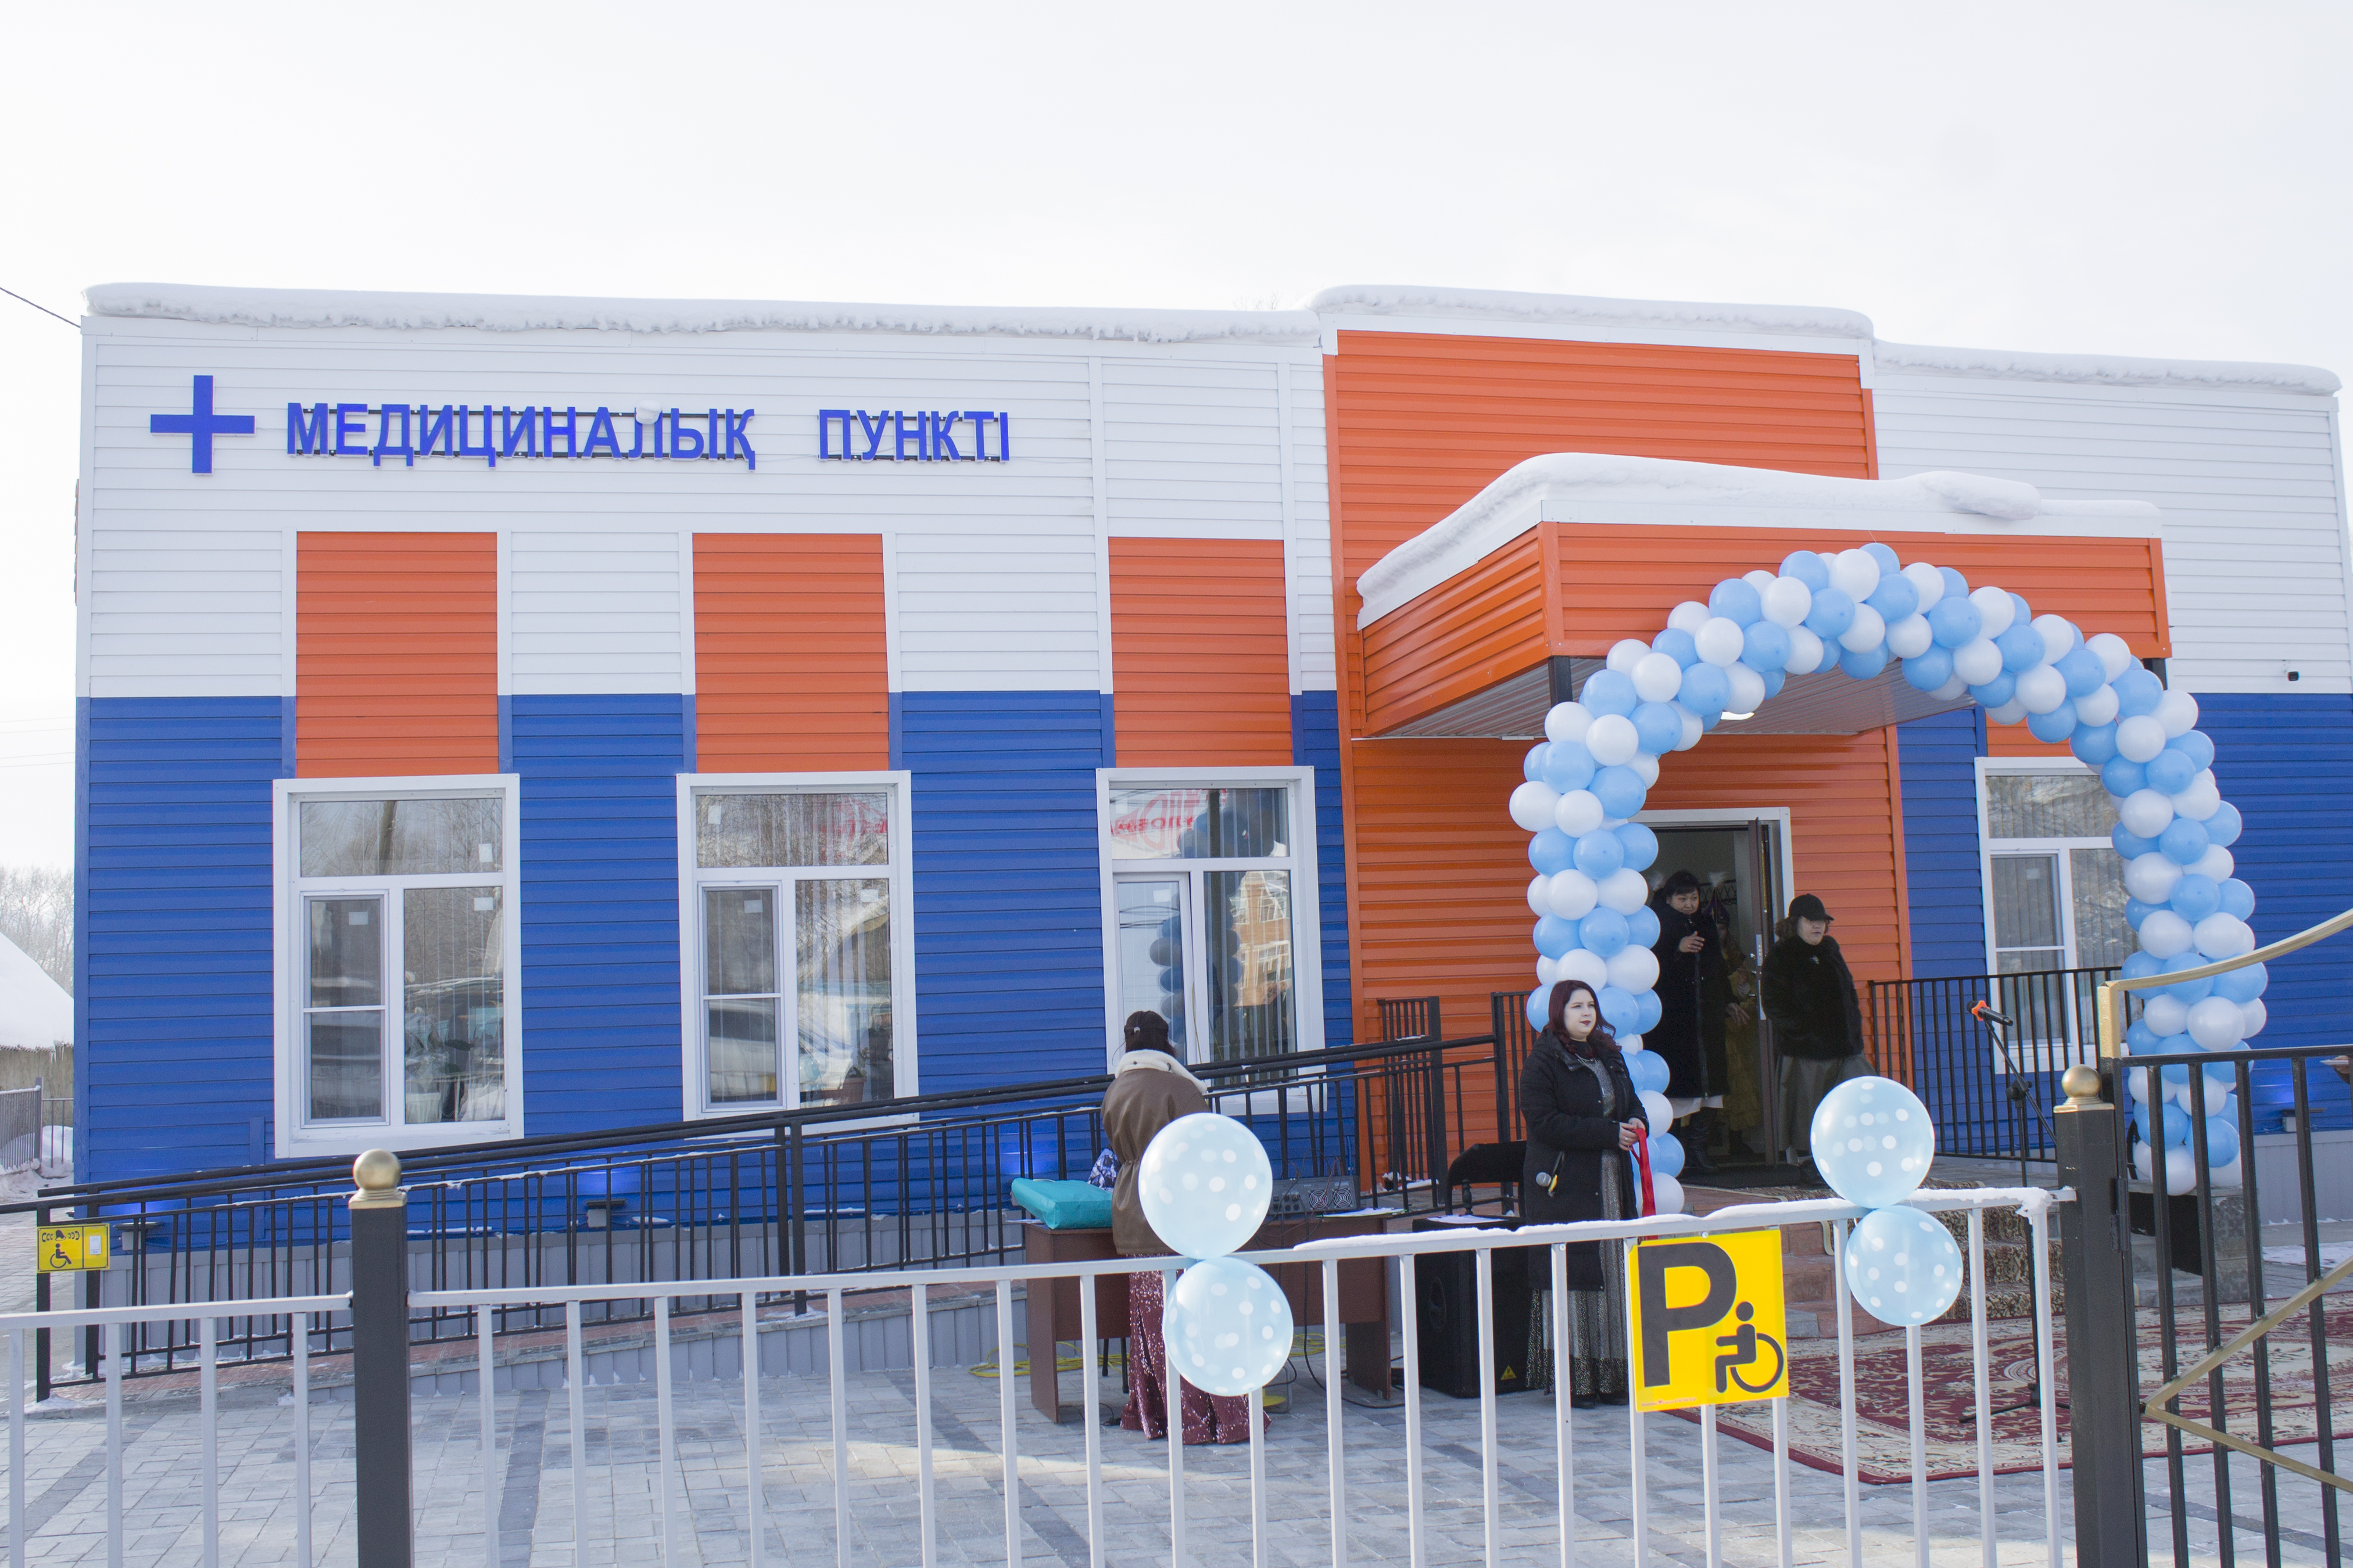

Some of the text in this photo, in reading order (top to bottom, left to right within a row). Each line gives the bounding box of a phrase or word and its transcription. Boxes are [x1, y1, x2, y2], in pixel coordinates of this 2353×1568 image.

[286, 402, 1009, 471] МЕДИЦИНАЛЫҚ ПУНКТІ
[1638, 1242, 1737, 1387] P
